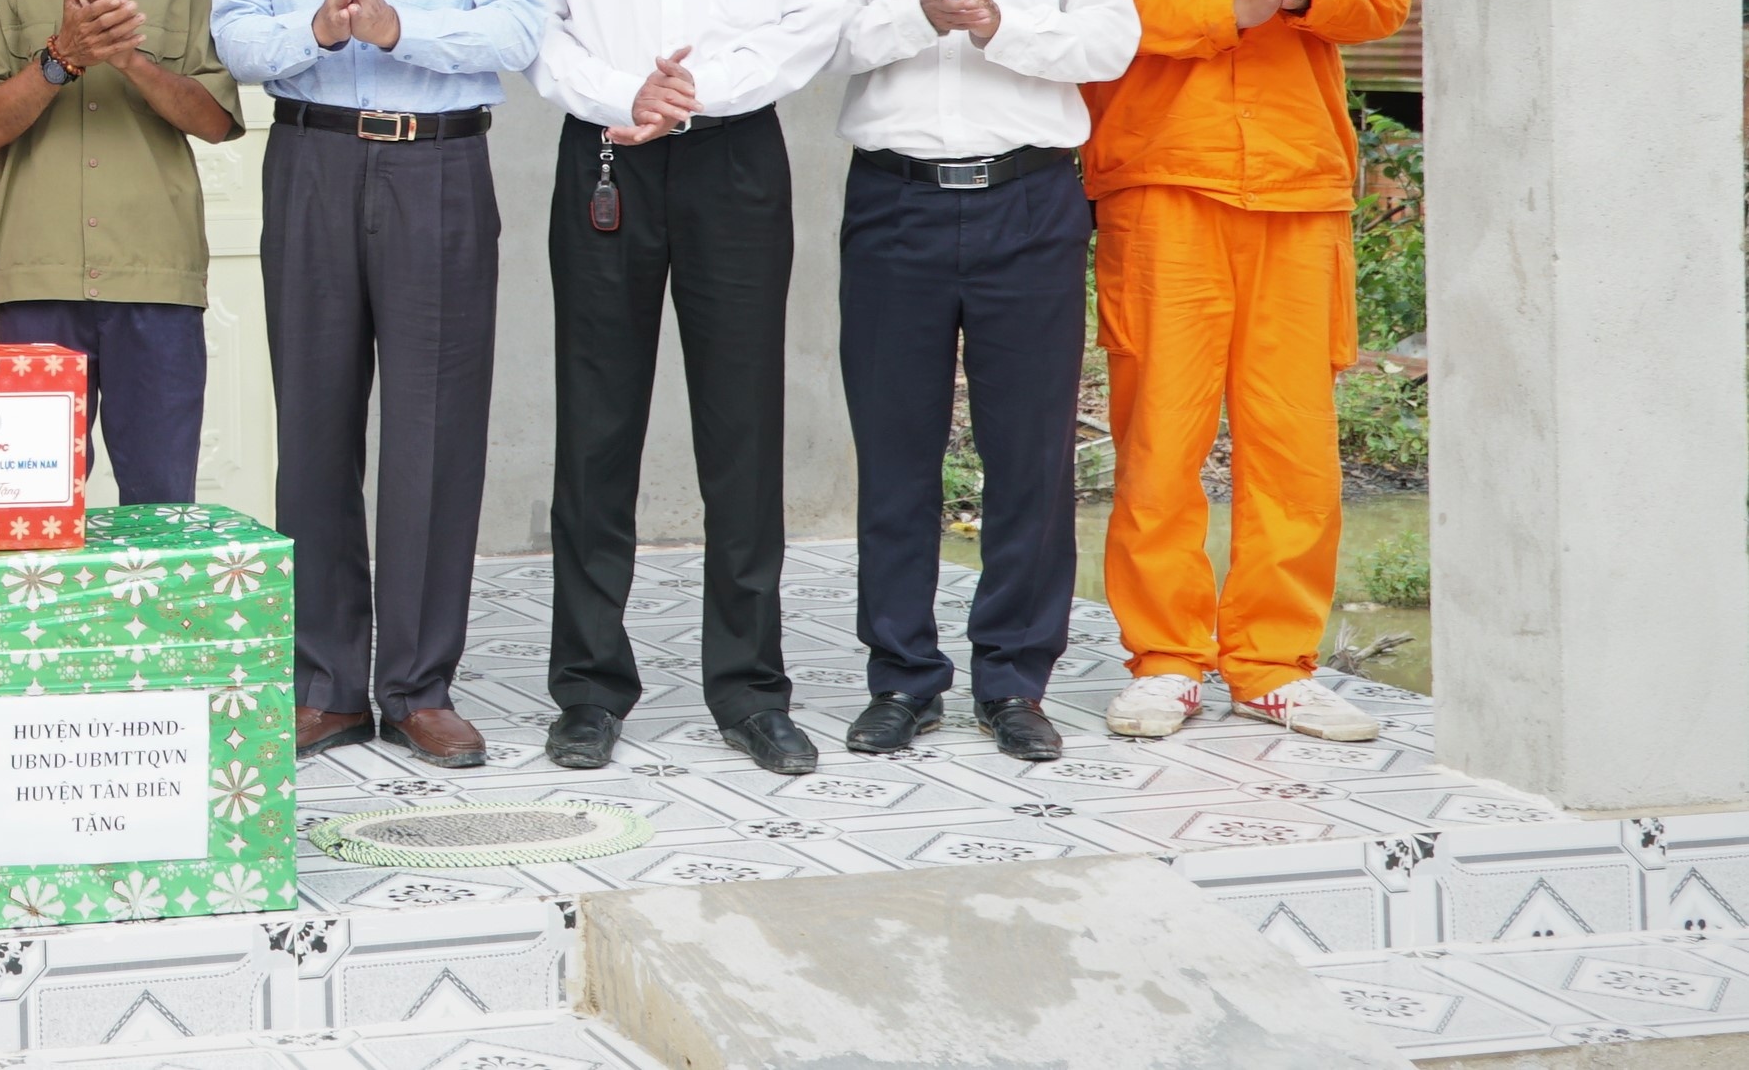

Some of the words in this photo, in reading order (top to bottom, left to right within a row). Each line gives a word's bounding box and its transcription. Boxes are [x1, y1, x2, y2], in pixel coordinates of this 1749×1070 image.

[40, 460, 57, 469] NAM
[14, 719, 81, 743] HUYỆN
[11, 749, 187, 770] UBND-UBMTTQVN
[16, 781, 83, 804] HUYỆN
[90, 779, 129, 799] TÂN
[137, 778, 181, 798] BIÊN
[72, 812, 125, 836] TẶNG
